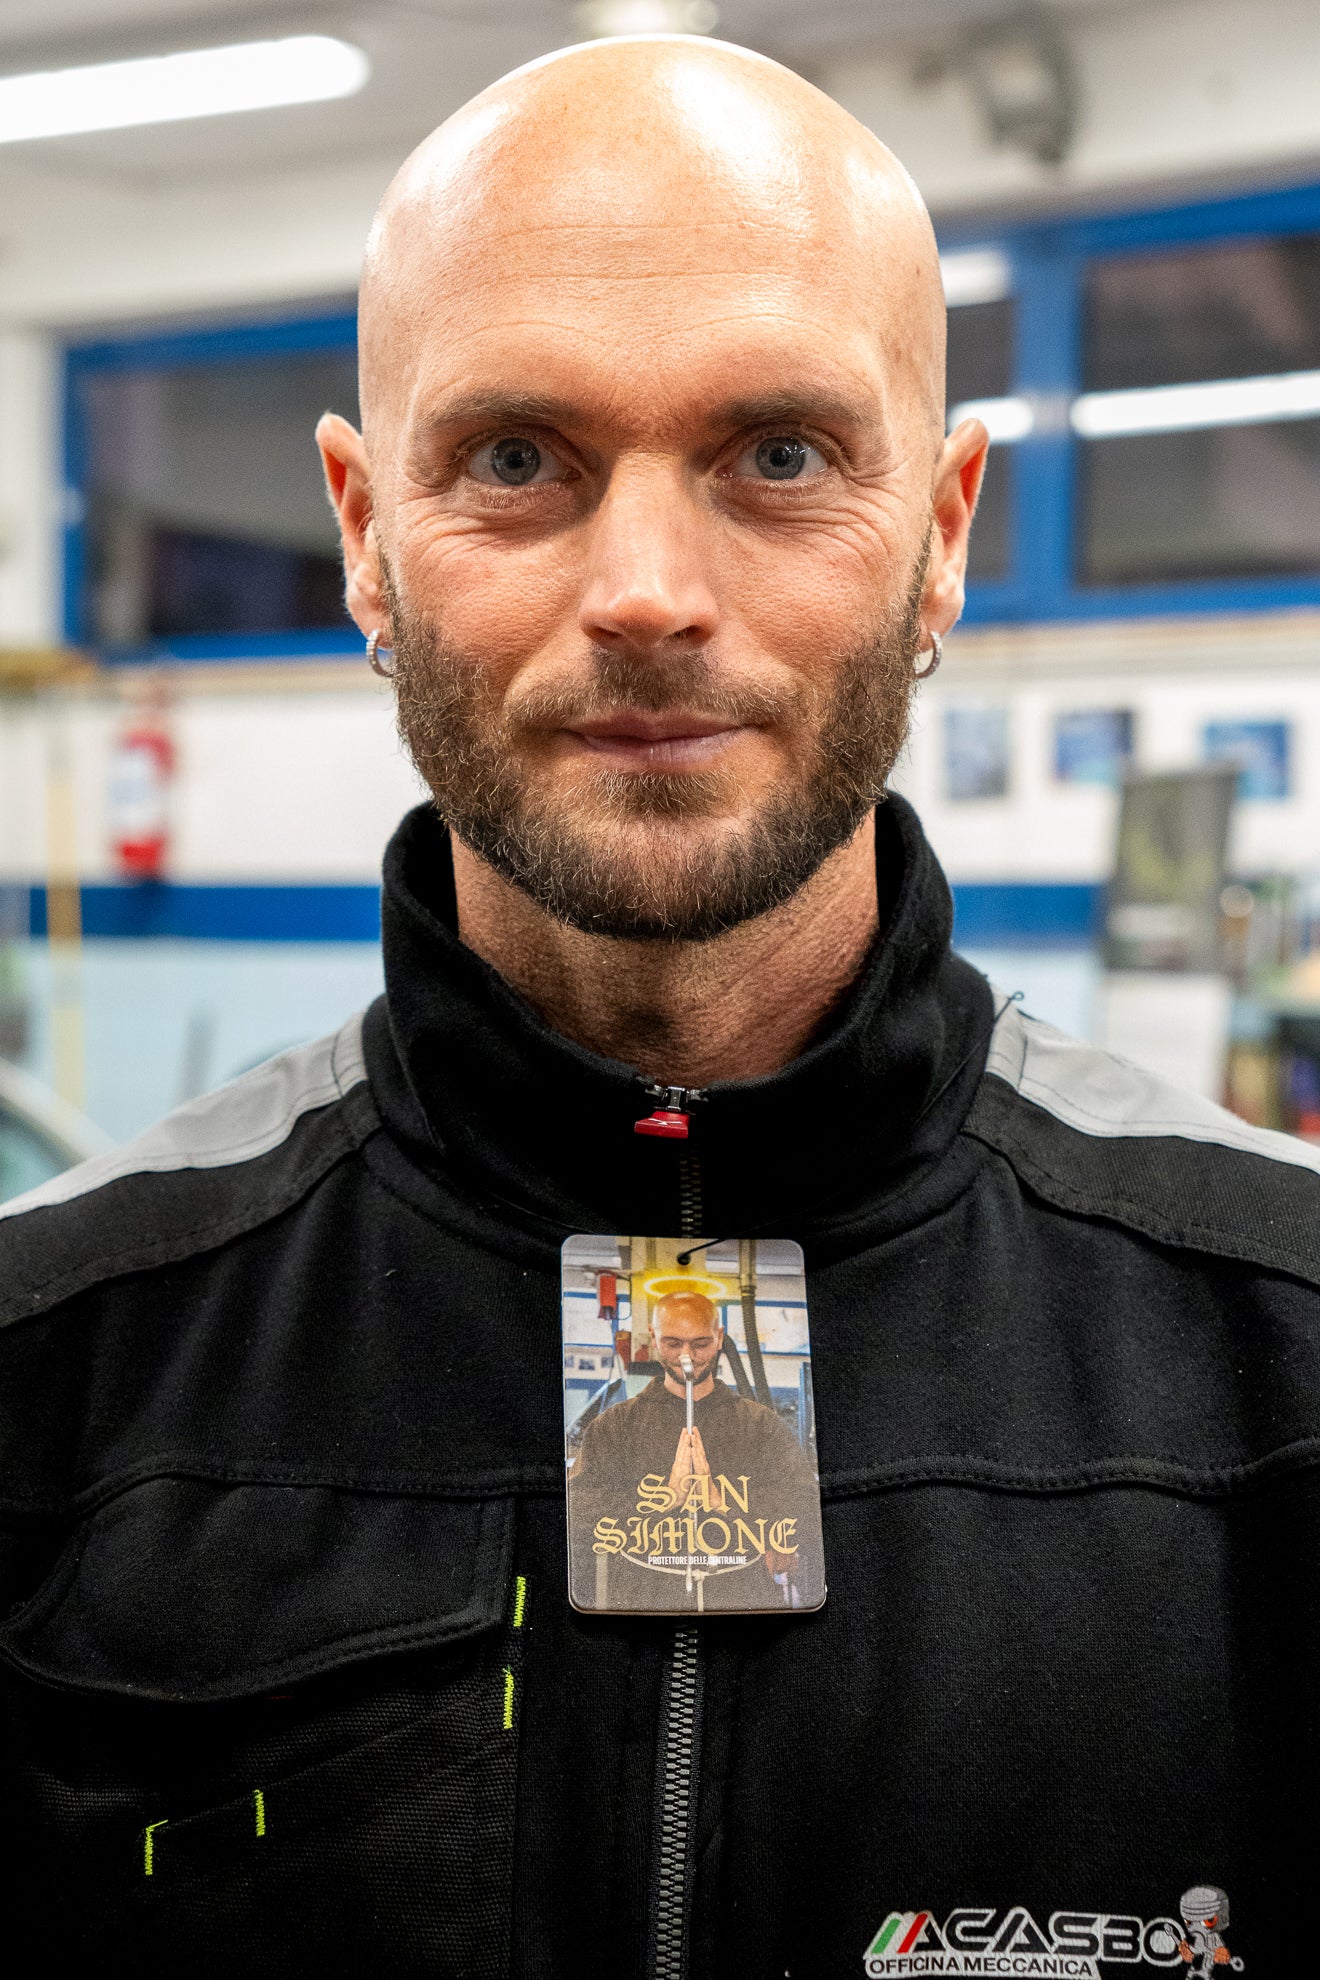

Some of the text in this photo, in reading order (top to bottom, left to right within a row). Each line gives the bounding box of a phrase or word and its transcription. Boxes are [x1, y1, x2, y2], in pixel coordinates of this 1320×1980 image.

[636, 1473, 751, 1514] SAN
[592, 1516, 799, 1555] SIMONE
[648, 1555, 688, 1565] PROTETTORE
[869, 1956, 1093, 1976] OFFICINA MECCANICA
